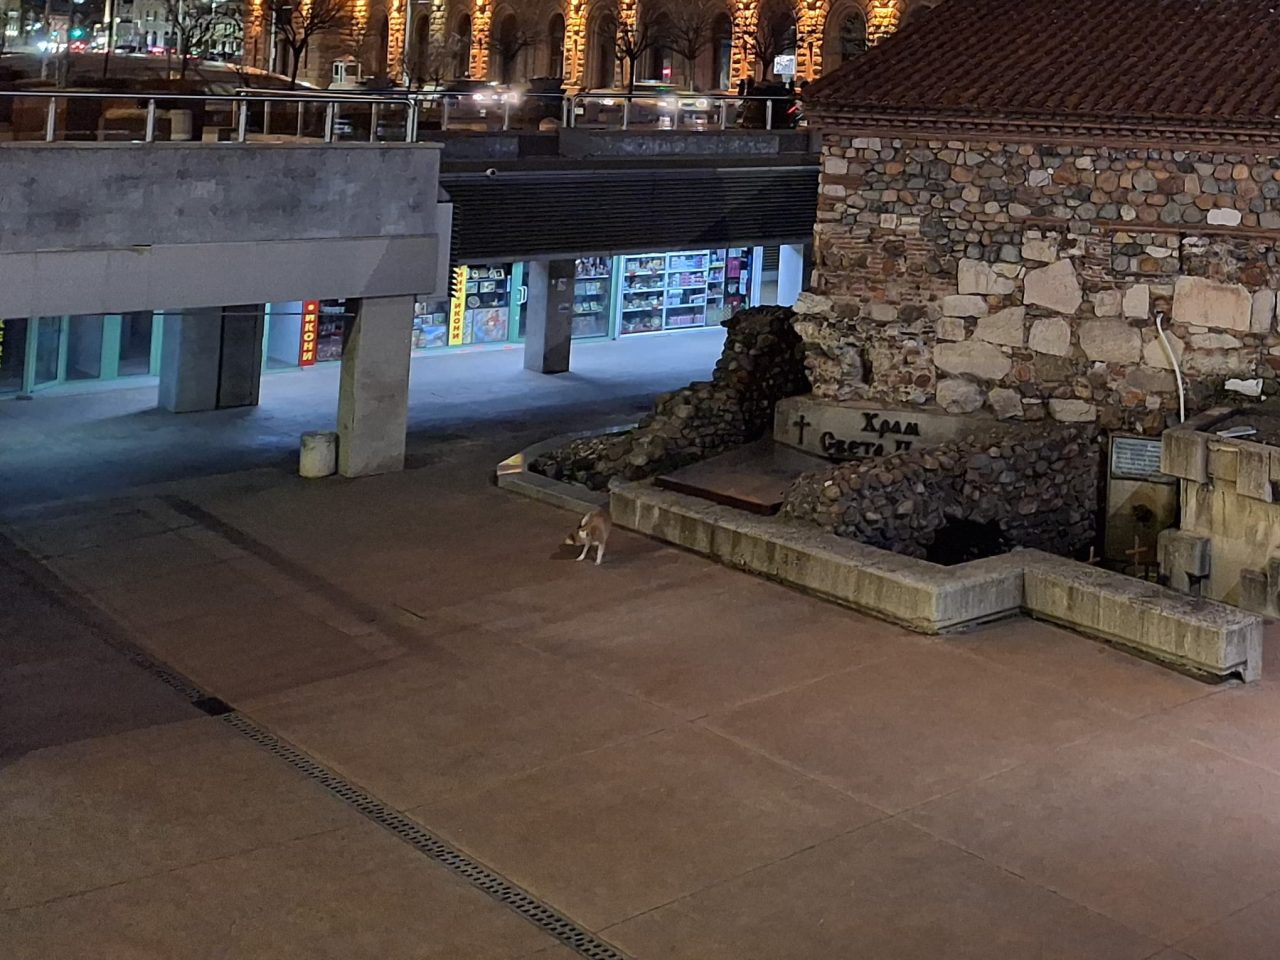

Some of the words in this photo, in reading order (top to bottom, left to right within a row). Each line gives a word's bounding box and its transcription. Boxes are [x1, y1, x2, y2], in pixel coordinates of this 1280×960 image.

[452, 302, 462, 340] ИКОНИ
[302, 314, 315, 361] ИКОНИ
[861, 412, 920, 438] Храм
[820, 431, 884, 457] Света
